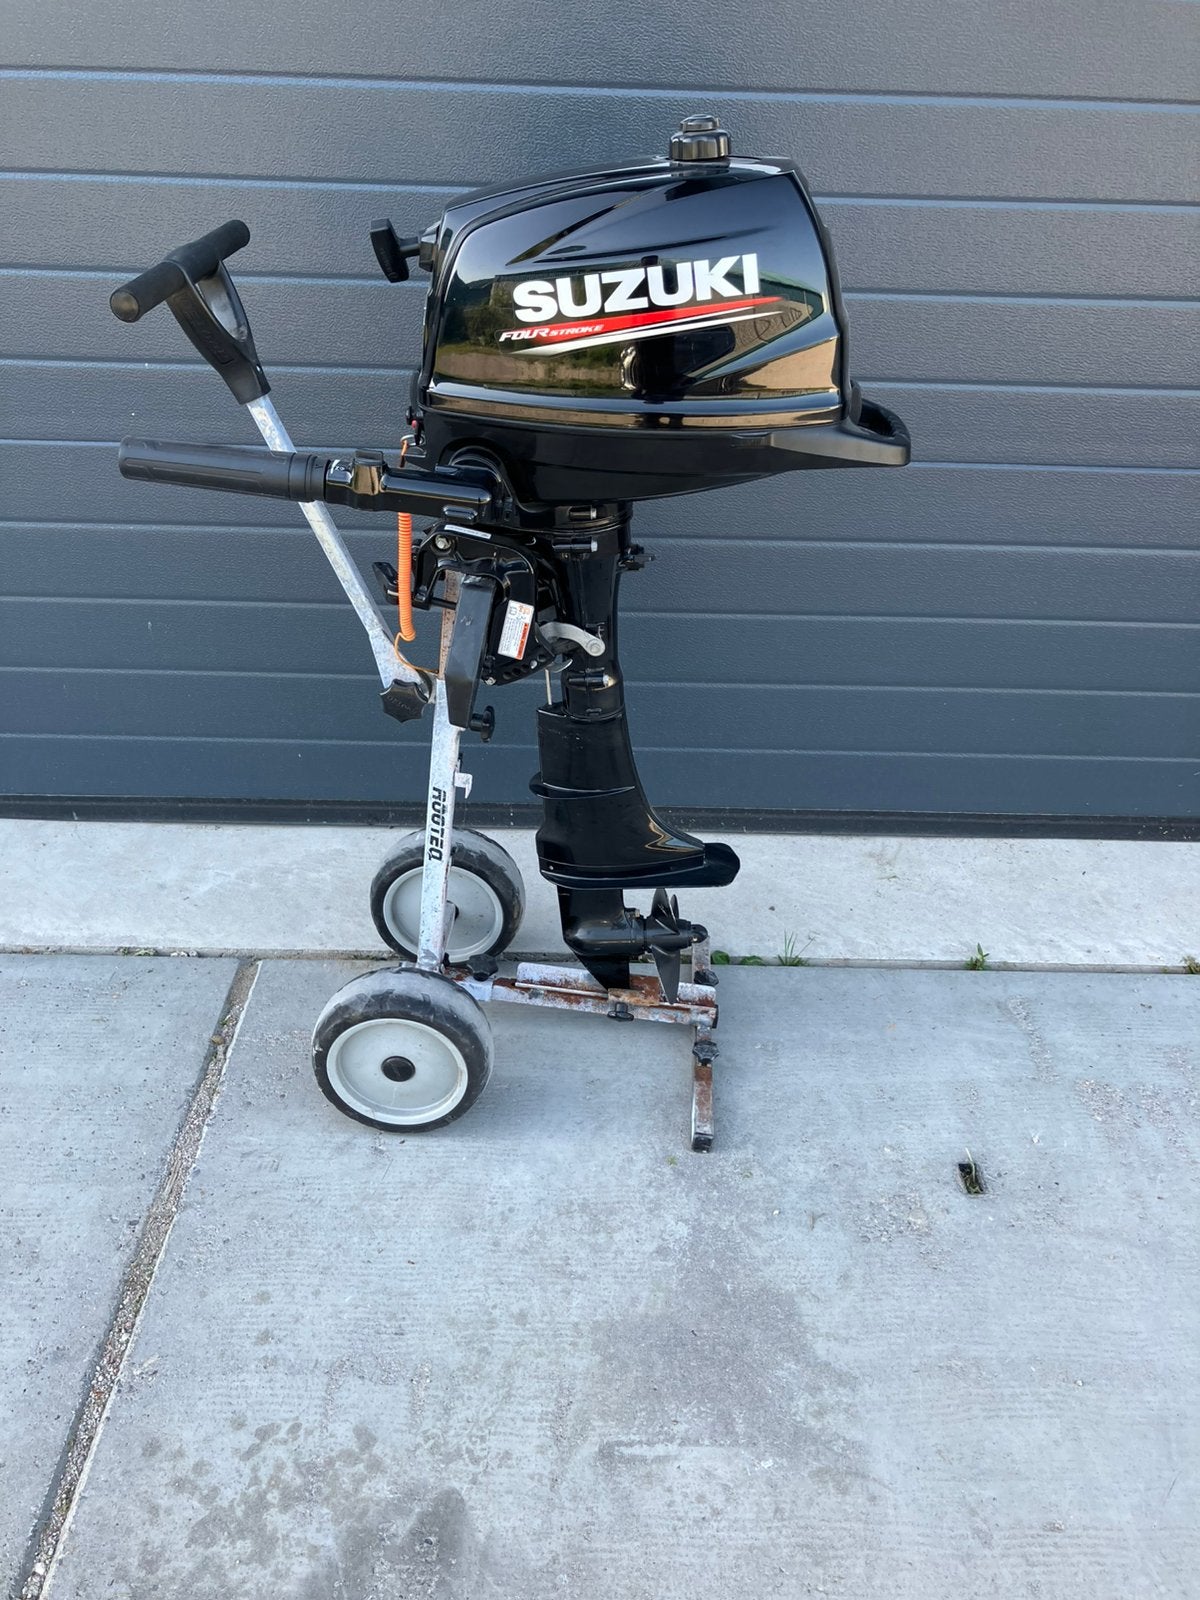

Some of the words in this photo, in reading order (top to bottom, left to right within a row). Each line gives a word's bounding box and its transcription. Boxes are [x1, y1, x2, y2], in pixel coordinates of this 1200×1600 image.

[512, 253, 760, 323] SUZUKI
[499, 327, 550, 342] FOUR
[549, 324, 604, 337] STROKE
[428, 786, 447, 861] ROOTEQ
